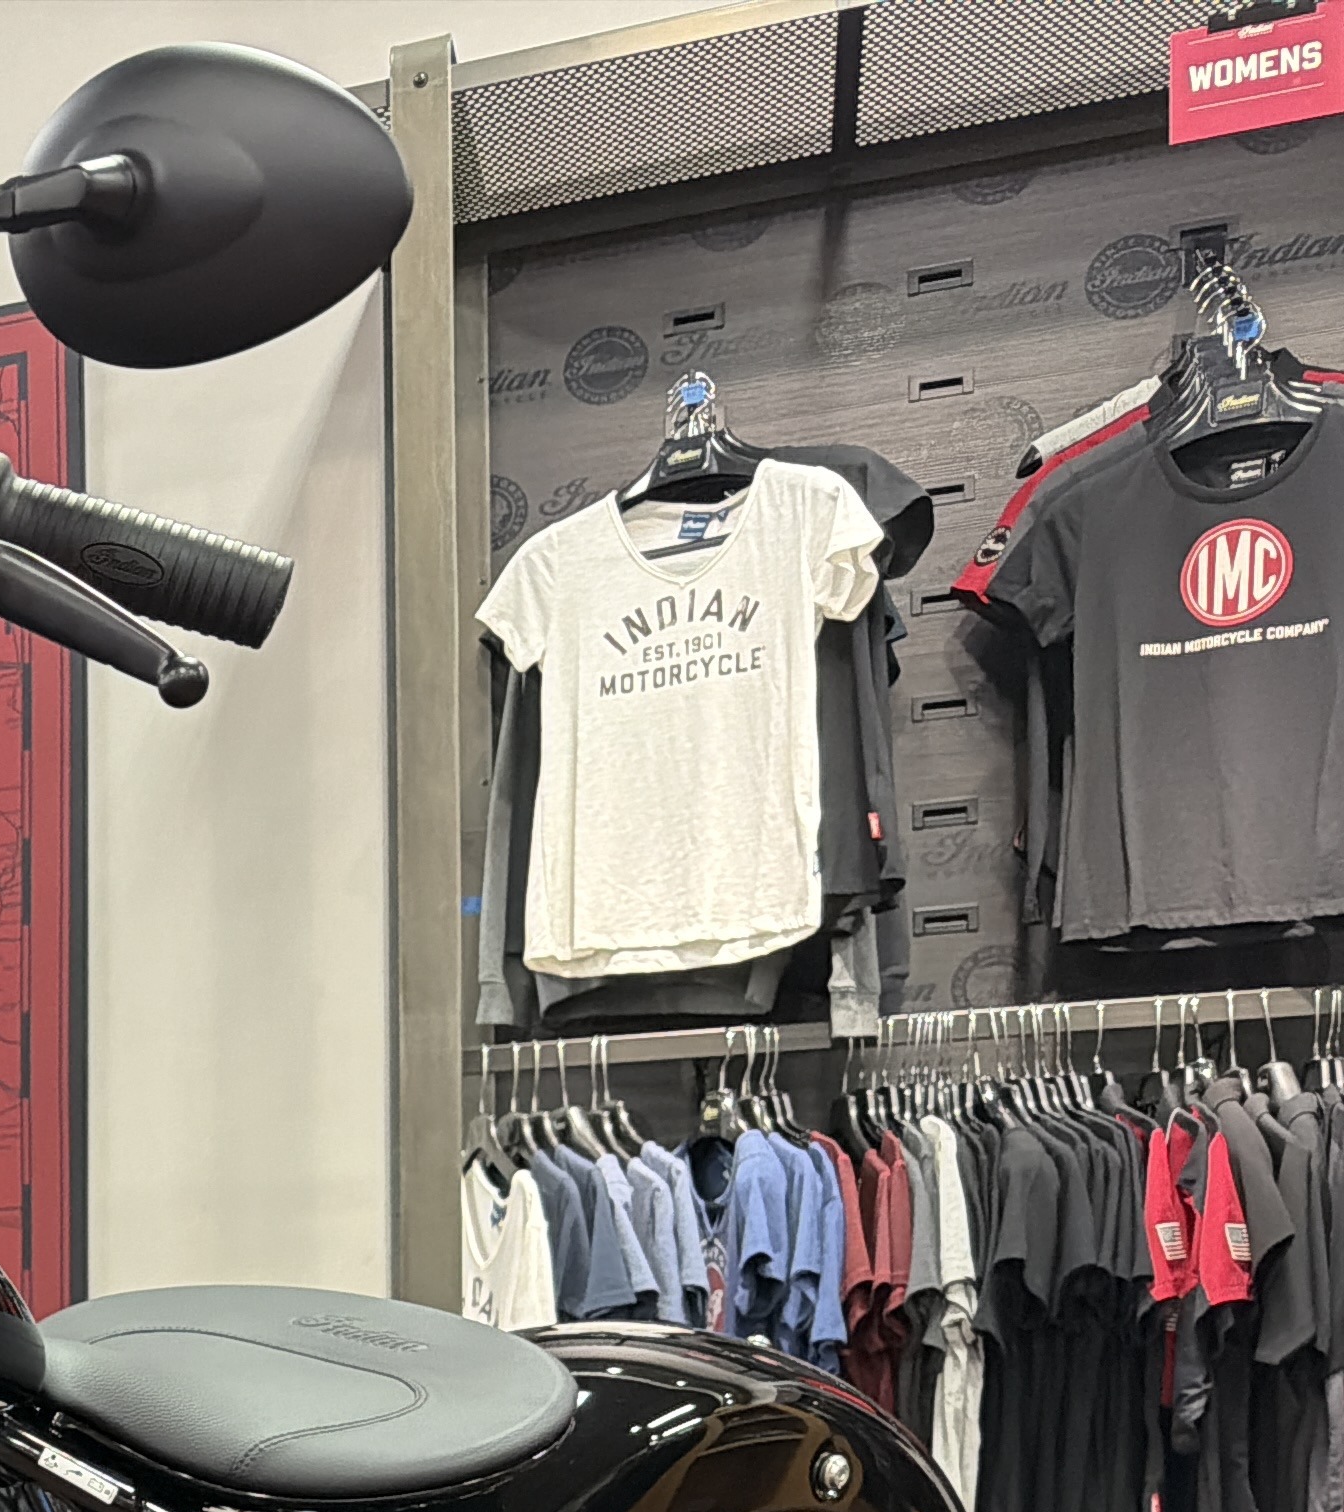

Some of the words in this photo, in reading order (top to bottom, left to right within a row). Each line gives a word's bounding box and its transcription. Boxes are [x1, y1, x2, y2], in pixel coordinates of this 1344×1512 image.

[1188, 40, 1324, 93] WOMENS
[1197, 529, 1278, 616] IMC
[602, 588, 761, 656] INDIAN
[642, 641, 681, 664] EST.
[684, 631, 722, 656] 1901
[1139, 641, 1182, 657] INDIAN
[1184, 628, 1263, 654] MOTORCYCLE
[1265, 620, 1325, 641] COMPANY
[599, 647, 763, 698] MOTORCYCLE
